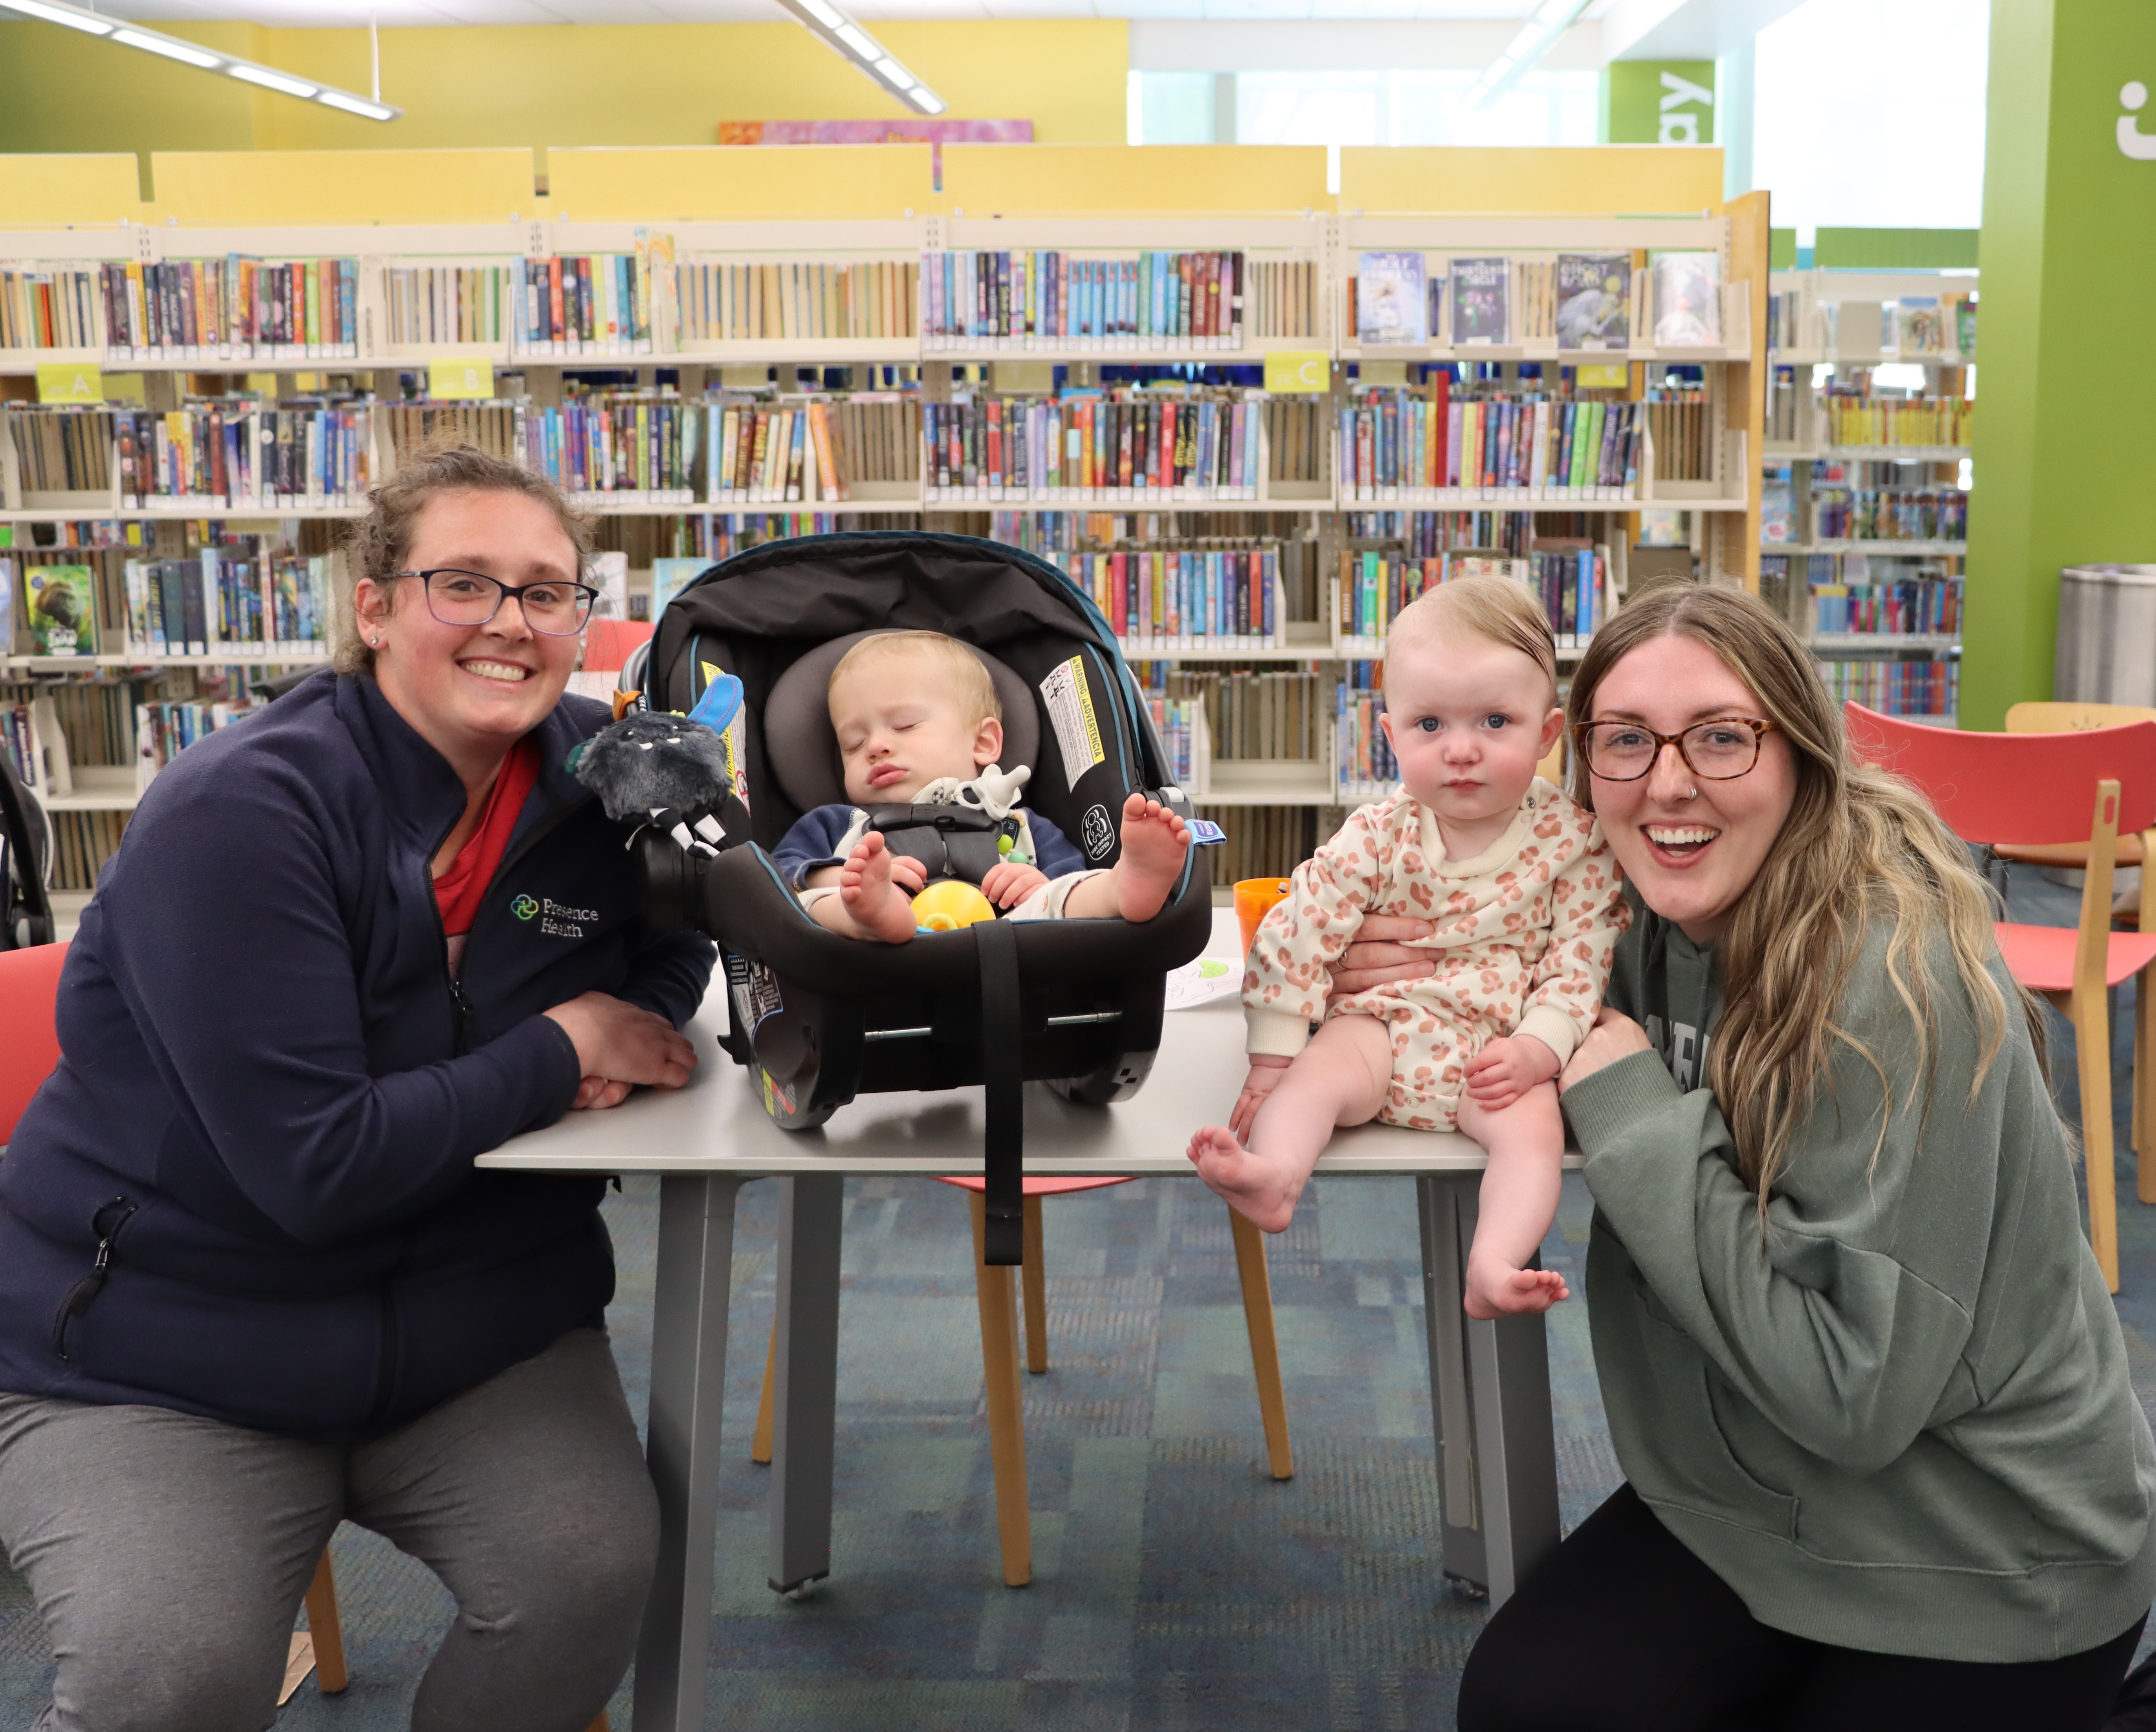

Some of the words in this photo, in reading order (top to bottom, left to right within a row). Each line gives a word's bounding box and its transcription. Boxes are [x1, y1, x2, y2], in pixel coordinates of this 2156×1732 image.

[72, 374, 92, 395] A
[464, 367, 480, 391] B
[1299, 361, 1319, 385] C
[1073, 662, 1087, 694] WARNING
[1083, 703, 1102, 757] ADVERTENCIA
[1076, 708, 1084, 731] STRANGLED
[1095, 841, 1110, 855] TESTED
[1097, 832, 1112, 847] IMPACT
[543, 898, 598, 921] Presence
[541, 917, 583, 937] Health
